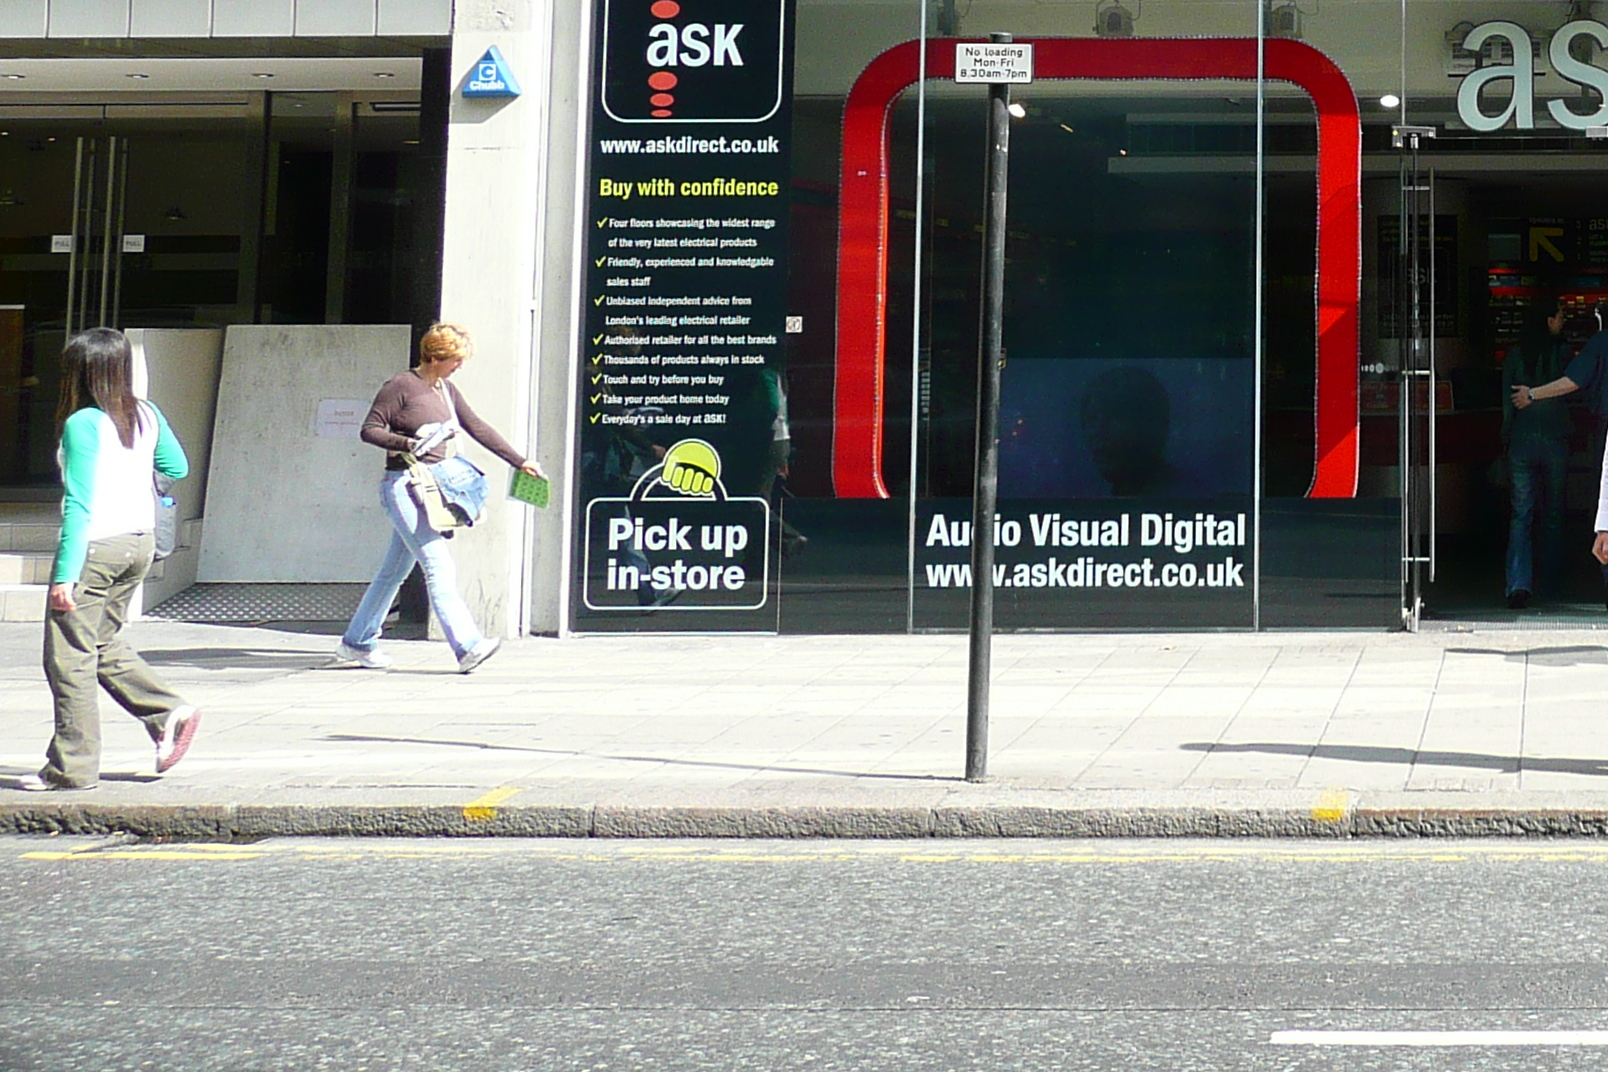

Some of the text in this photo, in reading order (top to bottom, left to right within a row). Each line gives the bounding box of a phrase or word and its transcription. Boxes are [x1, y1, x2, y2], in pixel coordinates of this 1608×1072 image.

[647, 24, 743, 67] ask
[965, 47, 1023, 58] No loading
[470, 80, 505, 91] Chubb
[601, 136, 778, 153] www.askdirect.co.uk
[600, 178, 778, 199] Buy with confidence
[609, 518, 747, 557] Pick up
[926, 513, 1246, 553] Auio Visual Digital
[608, 559, 744, 590] in-store
